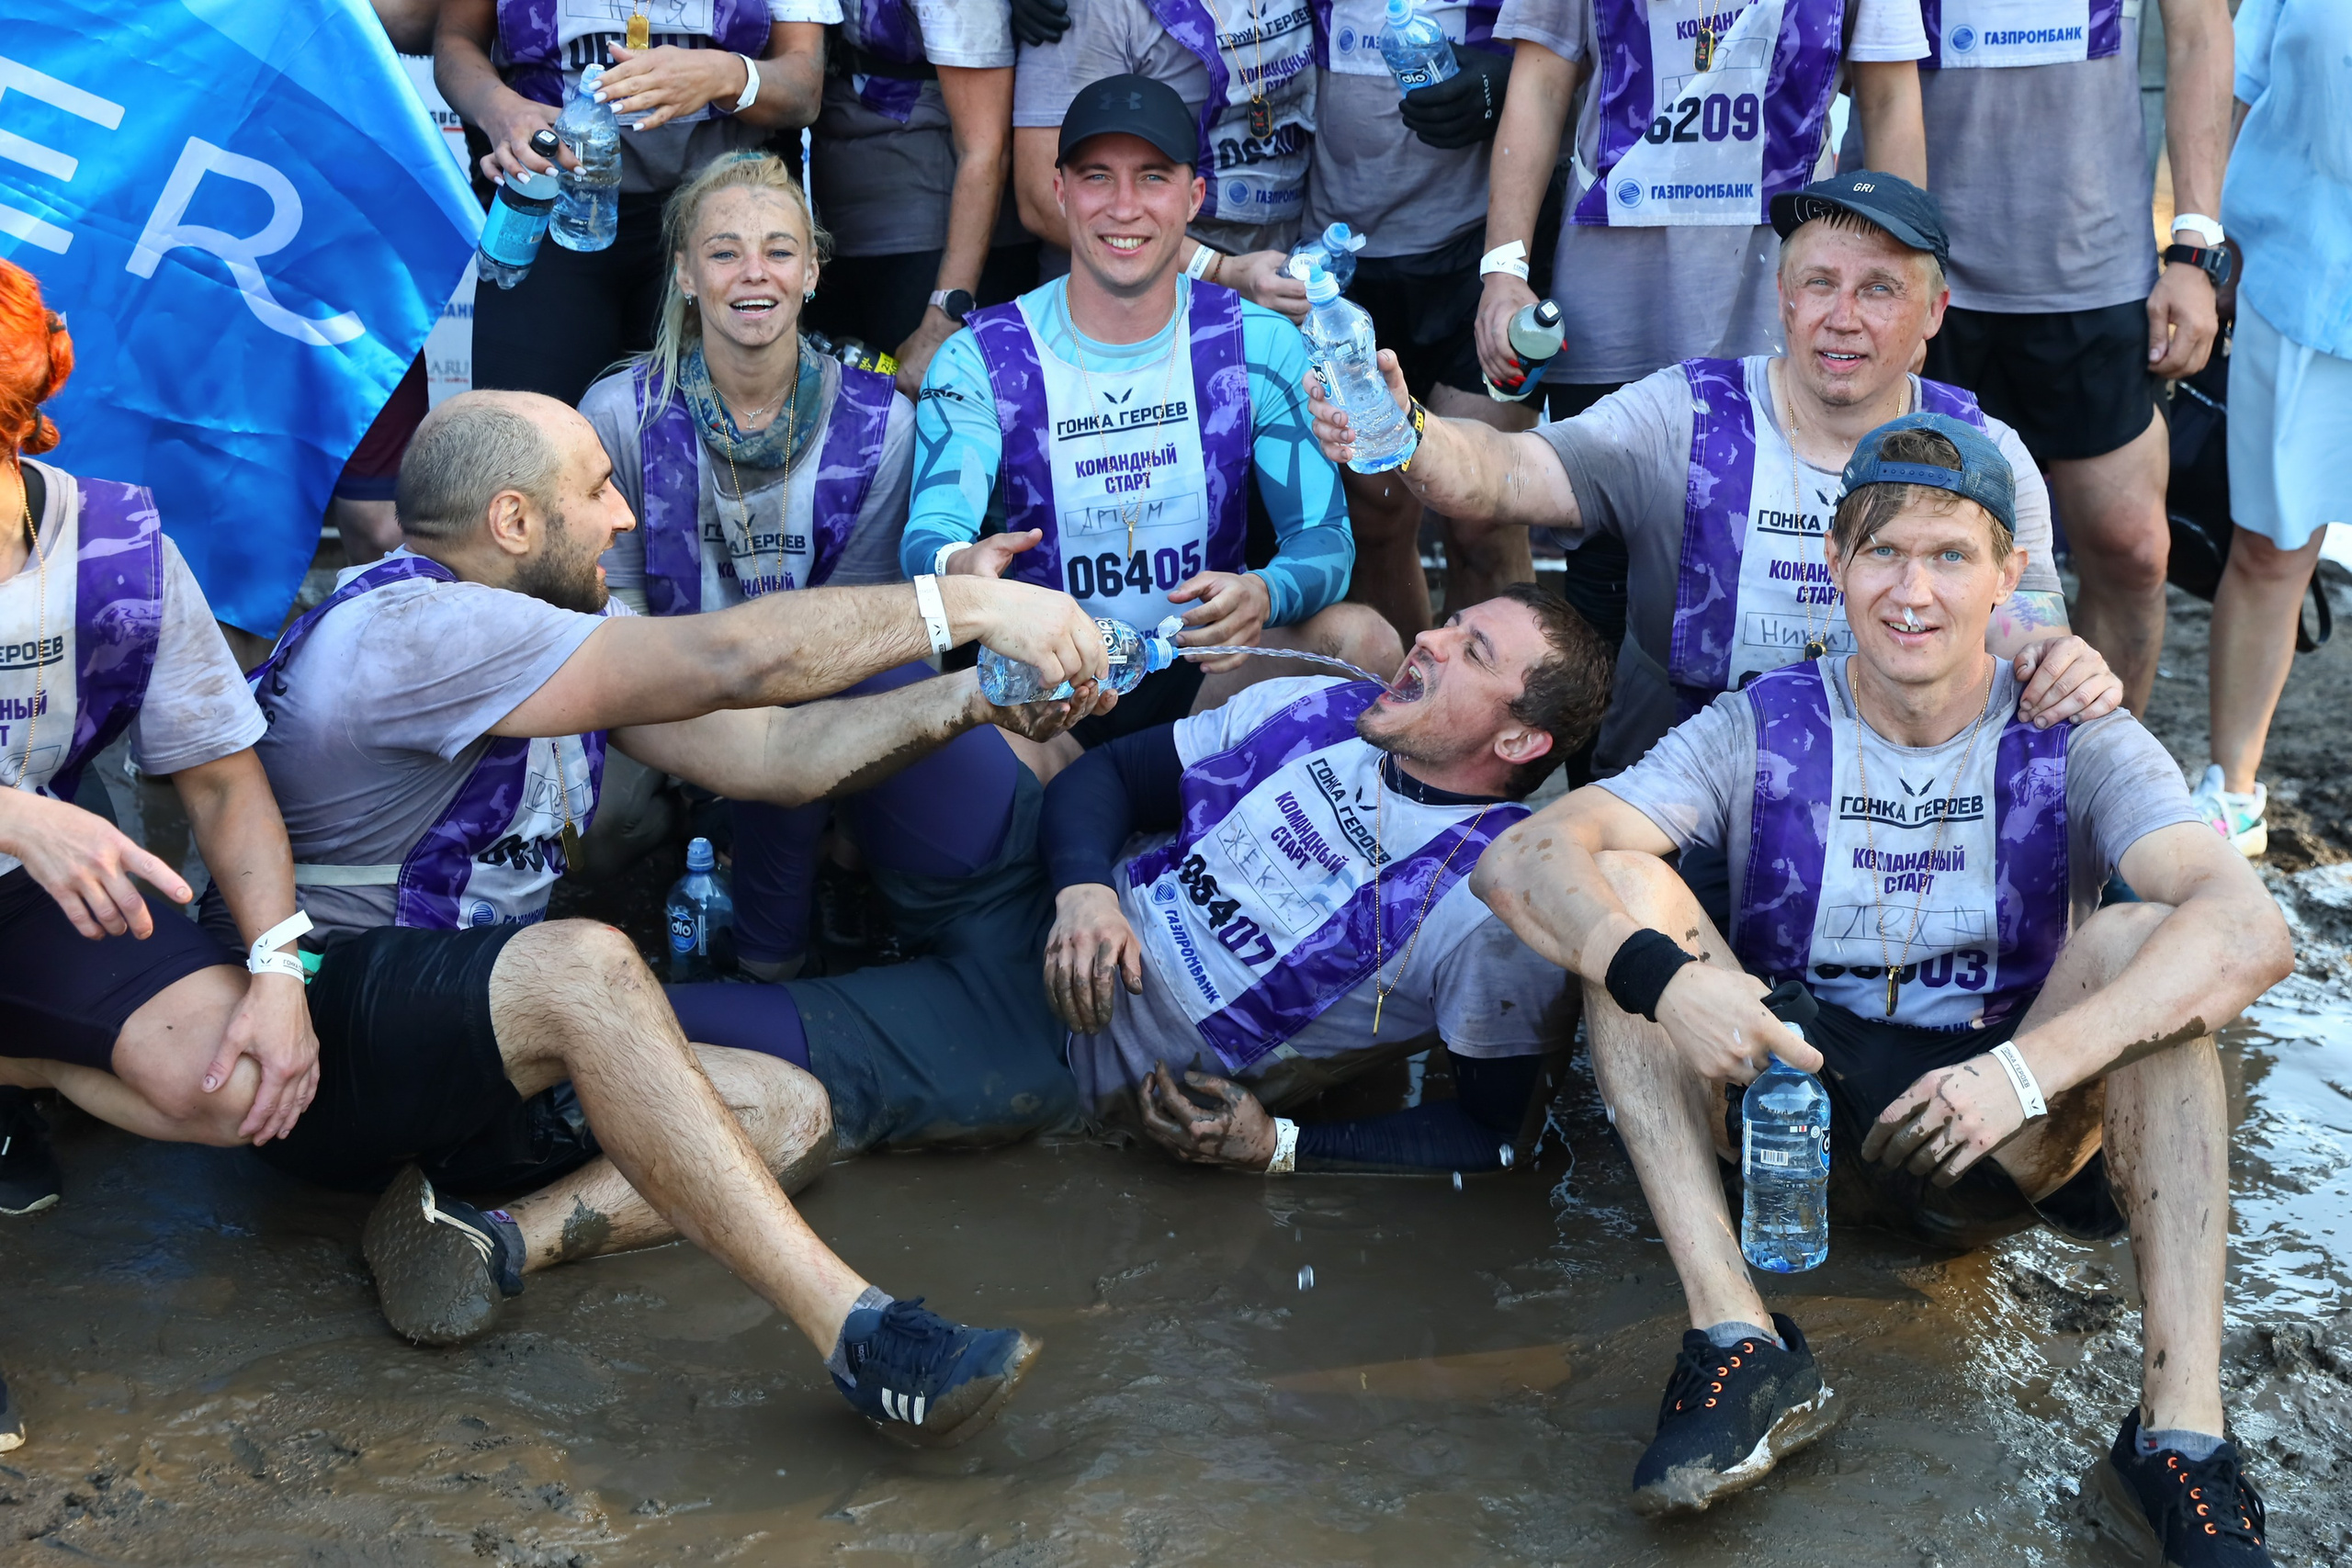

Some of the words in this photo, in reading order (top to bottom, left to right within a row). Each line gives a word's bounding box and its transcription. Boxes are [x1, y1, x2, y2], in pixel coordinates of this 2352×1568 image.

[1984, 27, 2082, 45] ГАЗПРОМБАНК
[1651, 184, 1754, 199] ГАЗПРОМБАНК
[1057, 412, 1114, 435] ГОНКА
[1120, 401, 1188, 425] ГЕРОЕВ
[1075, 443, 1178, 479] КОМАНДНЫЙ
[1104, 472, 1151, 494] СТАРТ
[1758, 509, 1821, 531] ГОНКА
[1068, 539, 1202, 600] 06405
[1312, 758, 1346, 802] ГОНКА
[1340, 806, 1392, 864] ГЕРОЕВ
[1839, 795, 1906, 822] ГОНКА
[1915, 795, 1984, 822] ГЕРОЕВ
[1271, 826, 1311, 870] СТАРТ
[1274, 791, 1350, 876] КОМАНДНЫЙ
[1852, 845, 1965, 874] КОМАНДНЫЙ
[1884, 873, 1935, 896] СТАРТ
[1165, 909, 1221, 1004] ГАЗПРОМБАНК
[2014, 1063, 2030, 1088] ГЕРОЕВ
